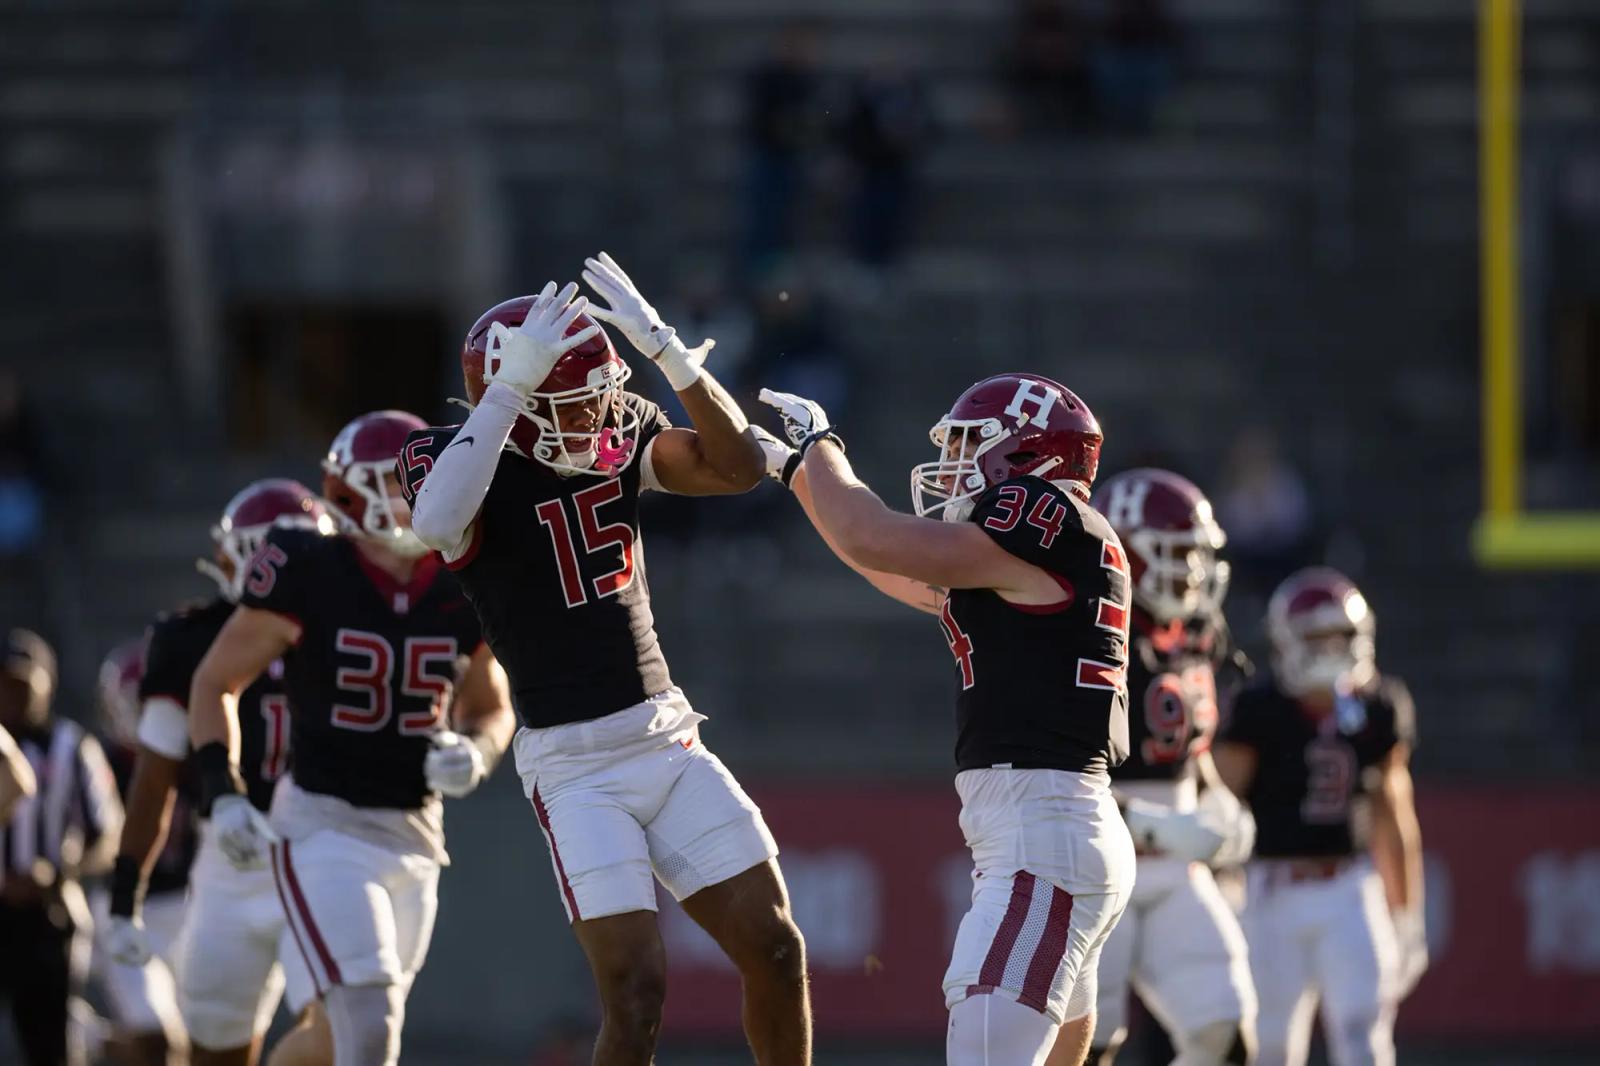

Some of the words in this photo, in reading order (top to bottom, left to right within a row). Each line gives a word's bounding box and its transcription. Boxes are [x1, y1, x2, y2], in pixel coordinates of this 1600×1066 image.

[1004, 378, 1061, 430] H
[395, 436, 434, 500] 15
[984, 485, 1067, 549] 34
[1108, 480, 1149, 528] H
[535, 477, 635, 608] 15
[330, 628, 458, 734] 35
